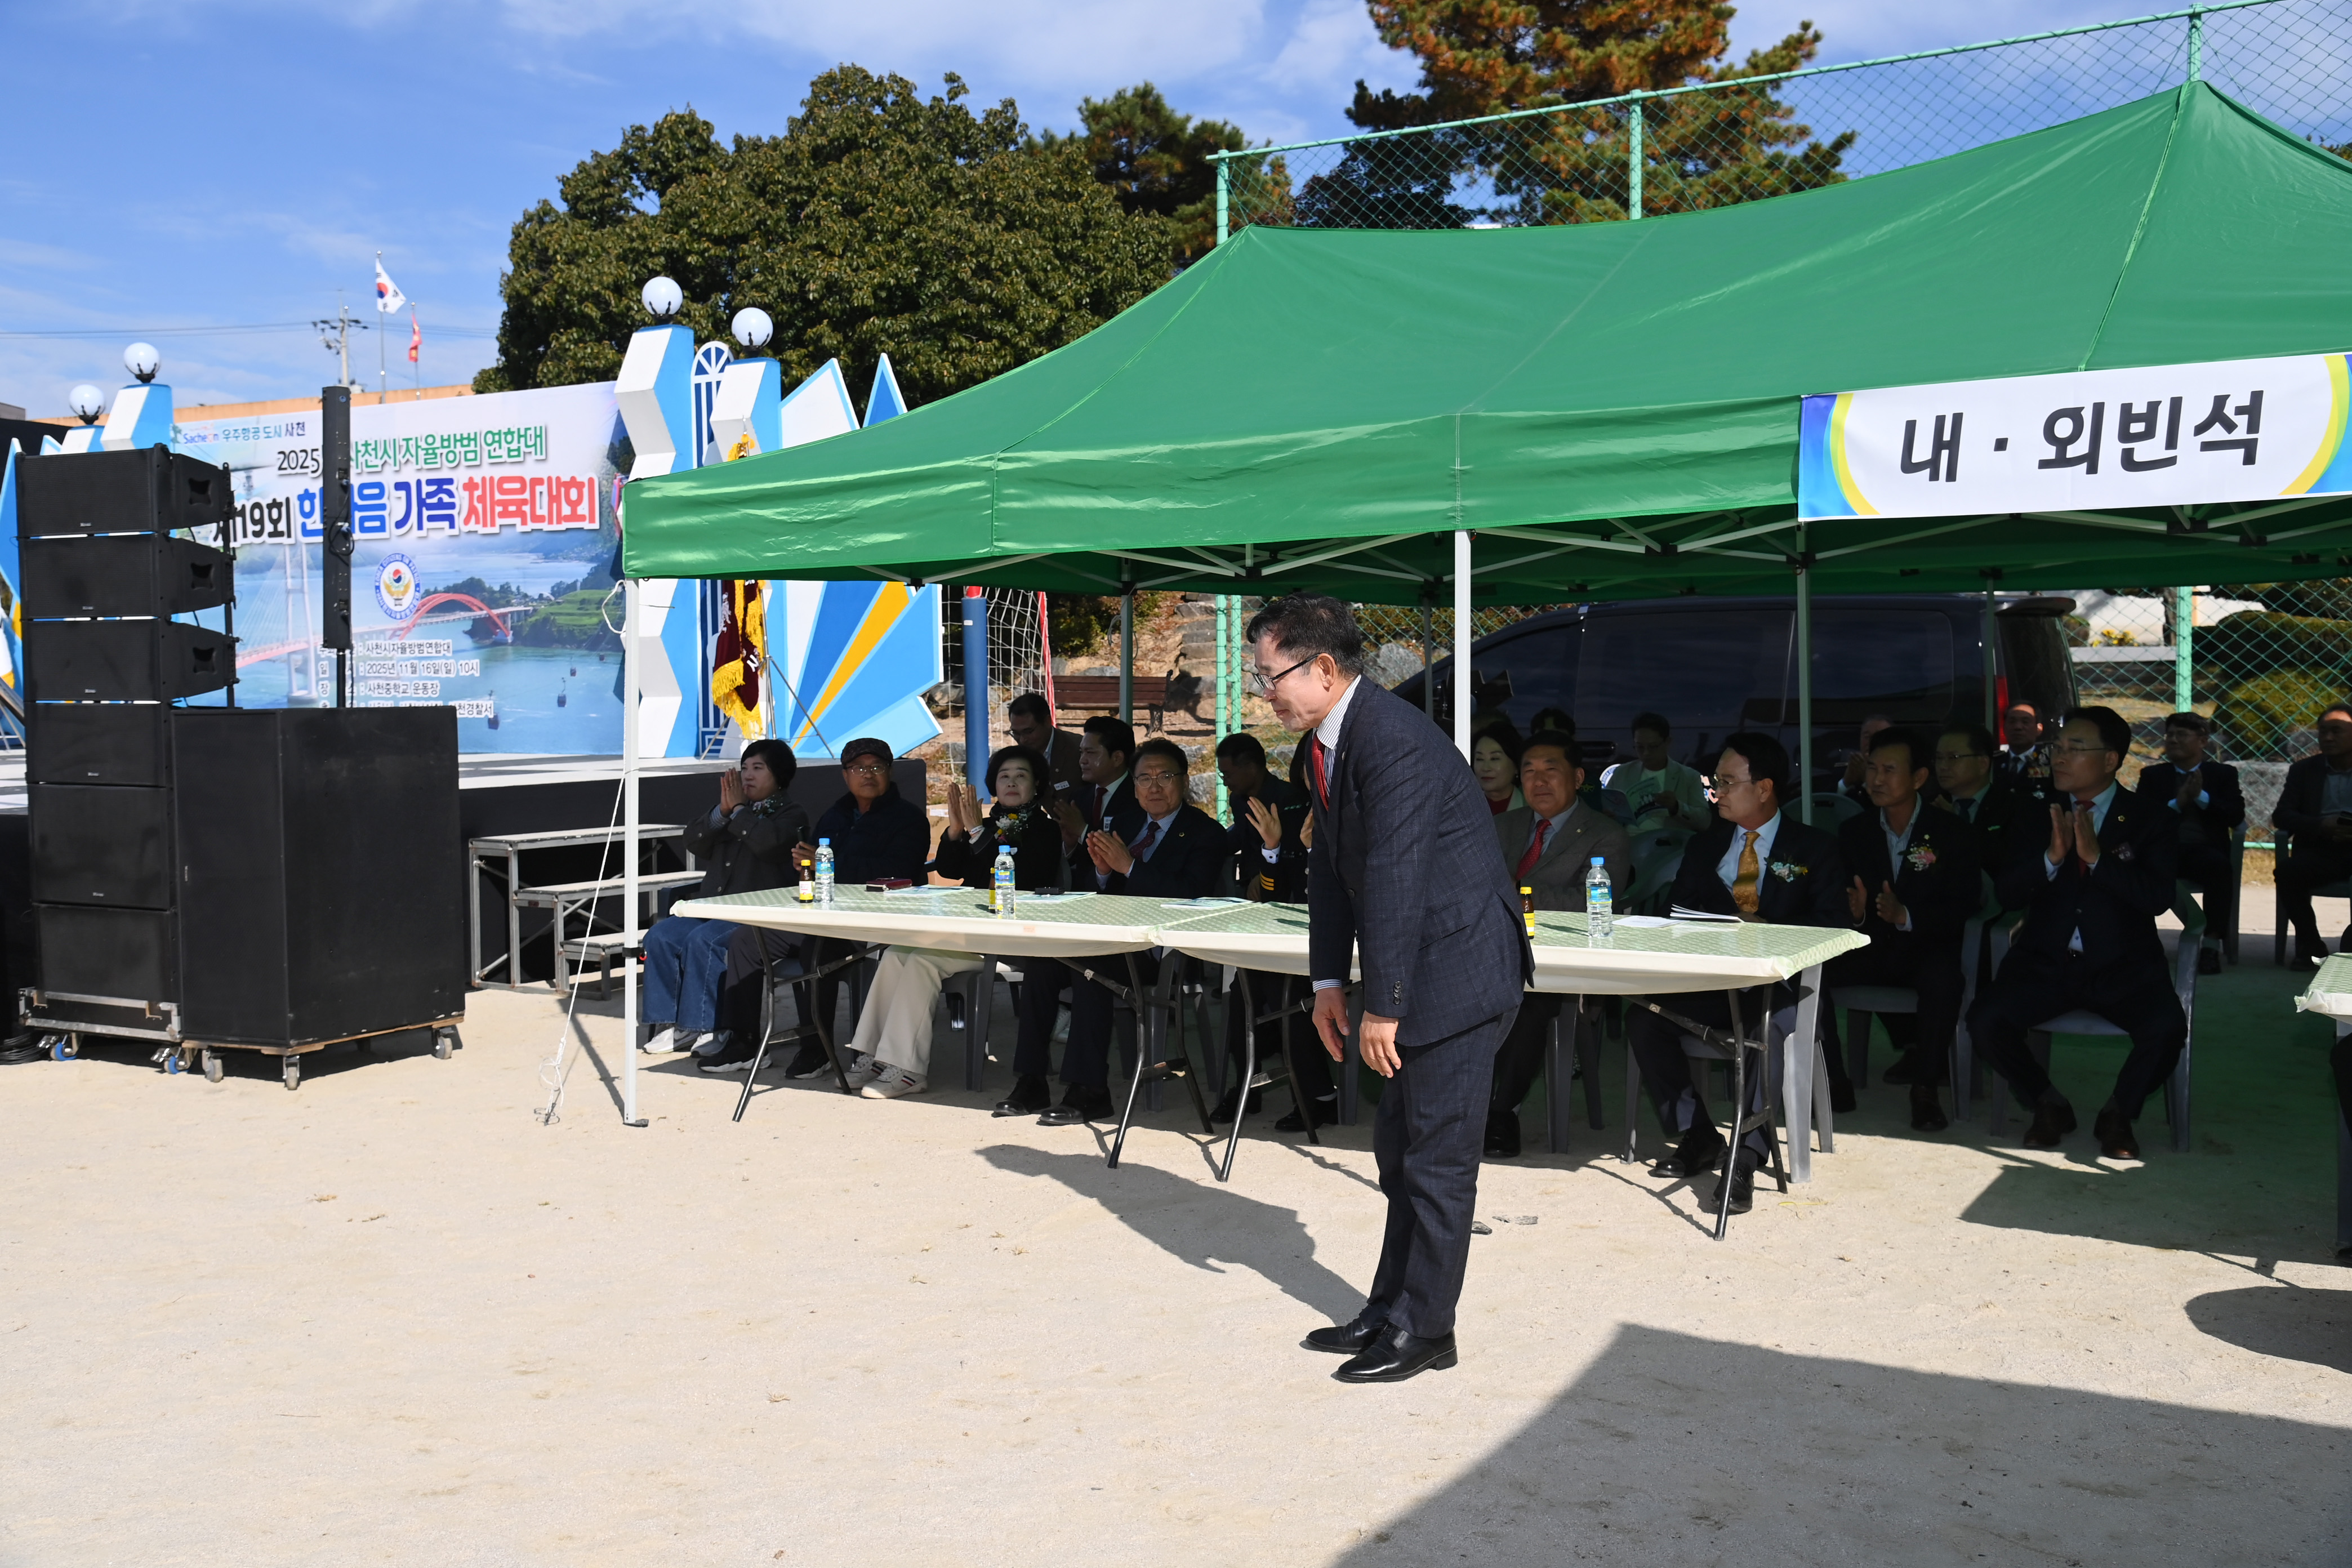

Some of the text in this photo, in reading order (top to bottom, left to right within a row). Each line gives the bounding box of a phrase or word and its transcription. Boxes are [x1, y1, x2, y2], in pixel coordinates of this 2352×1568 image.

[285, 421, 306, 436] 사천
[483, 425, 544, 458] 연합대
[297, 482, 386, 537] 한음
[394, 478, 456, 531] 가족
[462, 476, 596, 528] 체육대회
[367, 640, 450, 654] 사천시자율방범연합대
[367, 662, 395, 675] 2025년
[399, 662, 417, 674] 11월
[460, 661, 479, 674] 10시
[368, 682, 409, 694] 사천중학교
[413, 681, 439, 695] 운동장
[452, 703, 492, 716] 천경찰서
